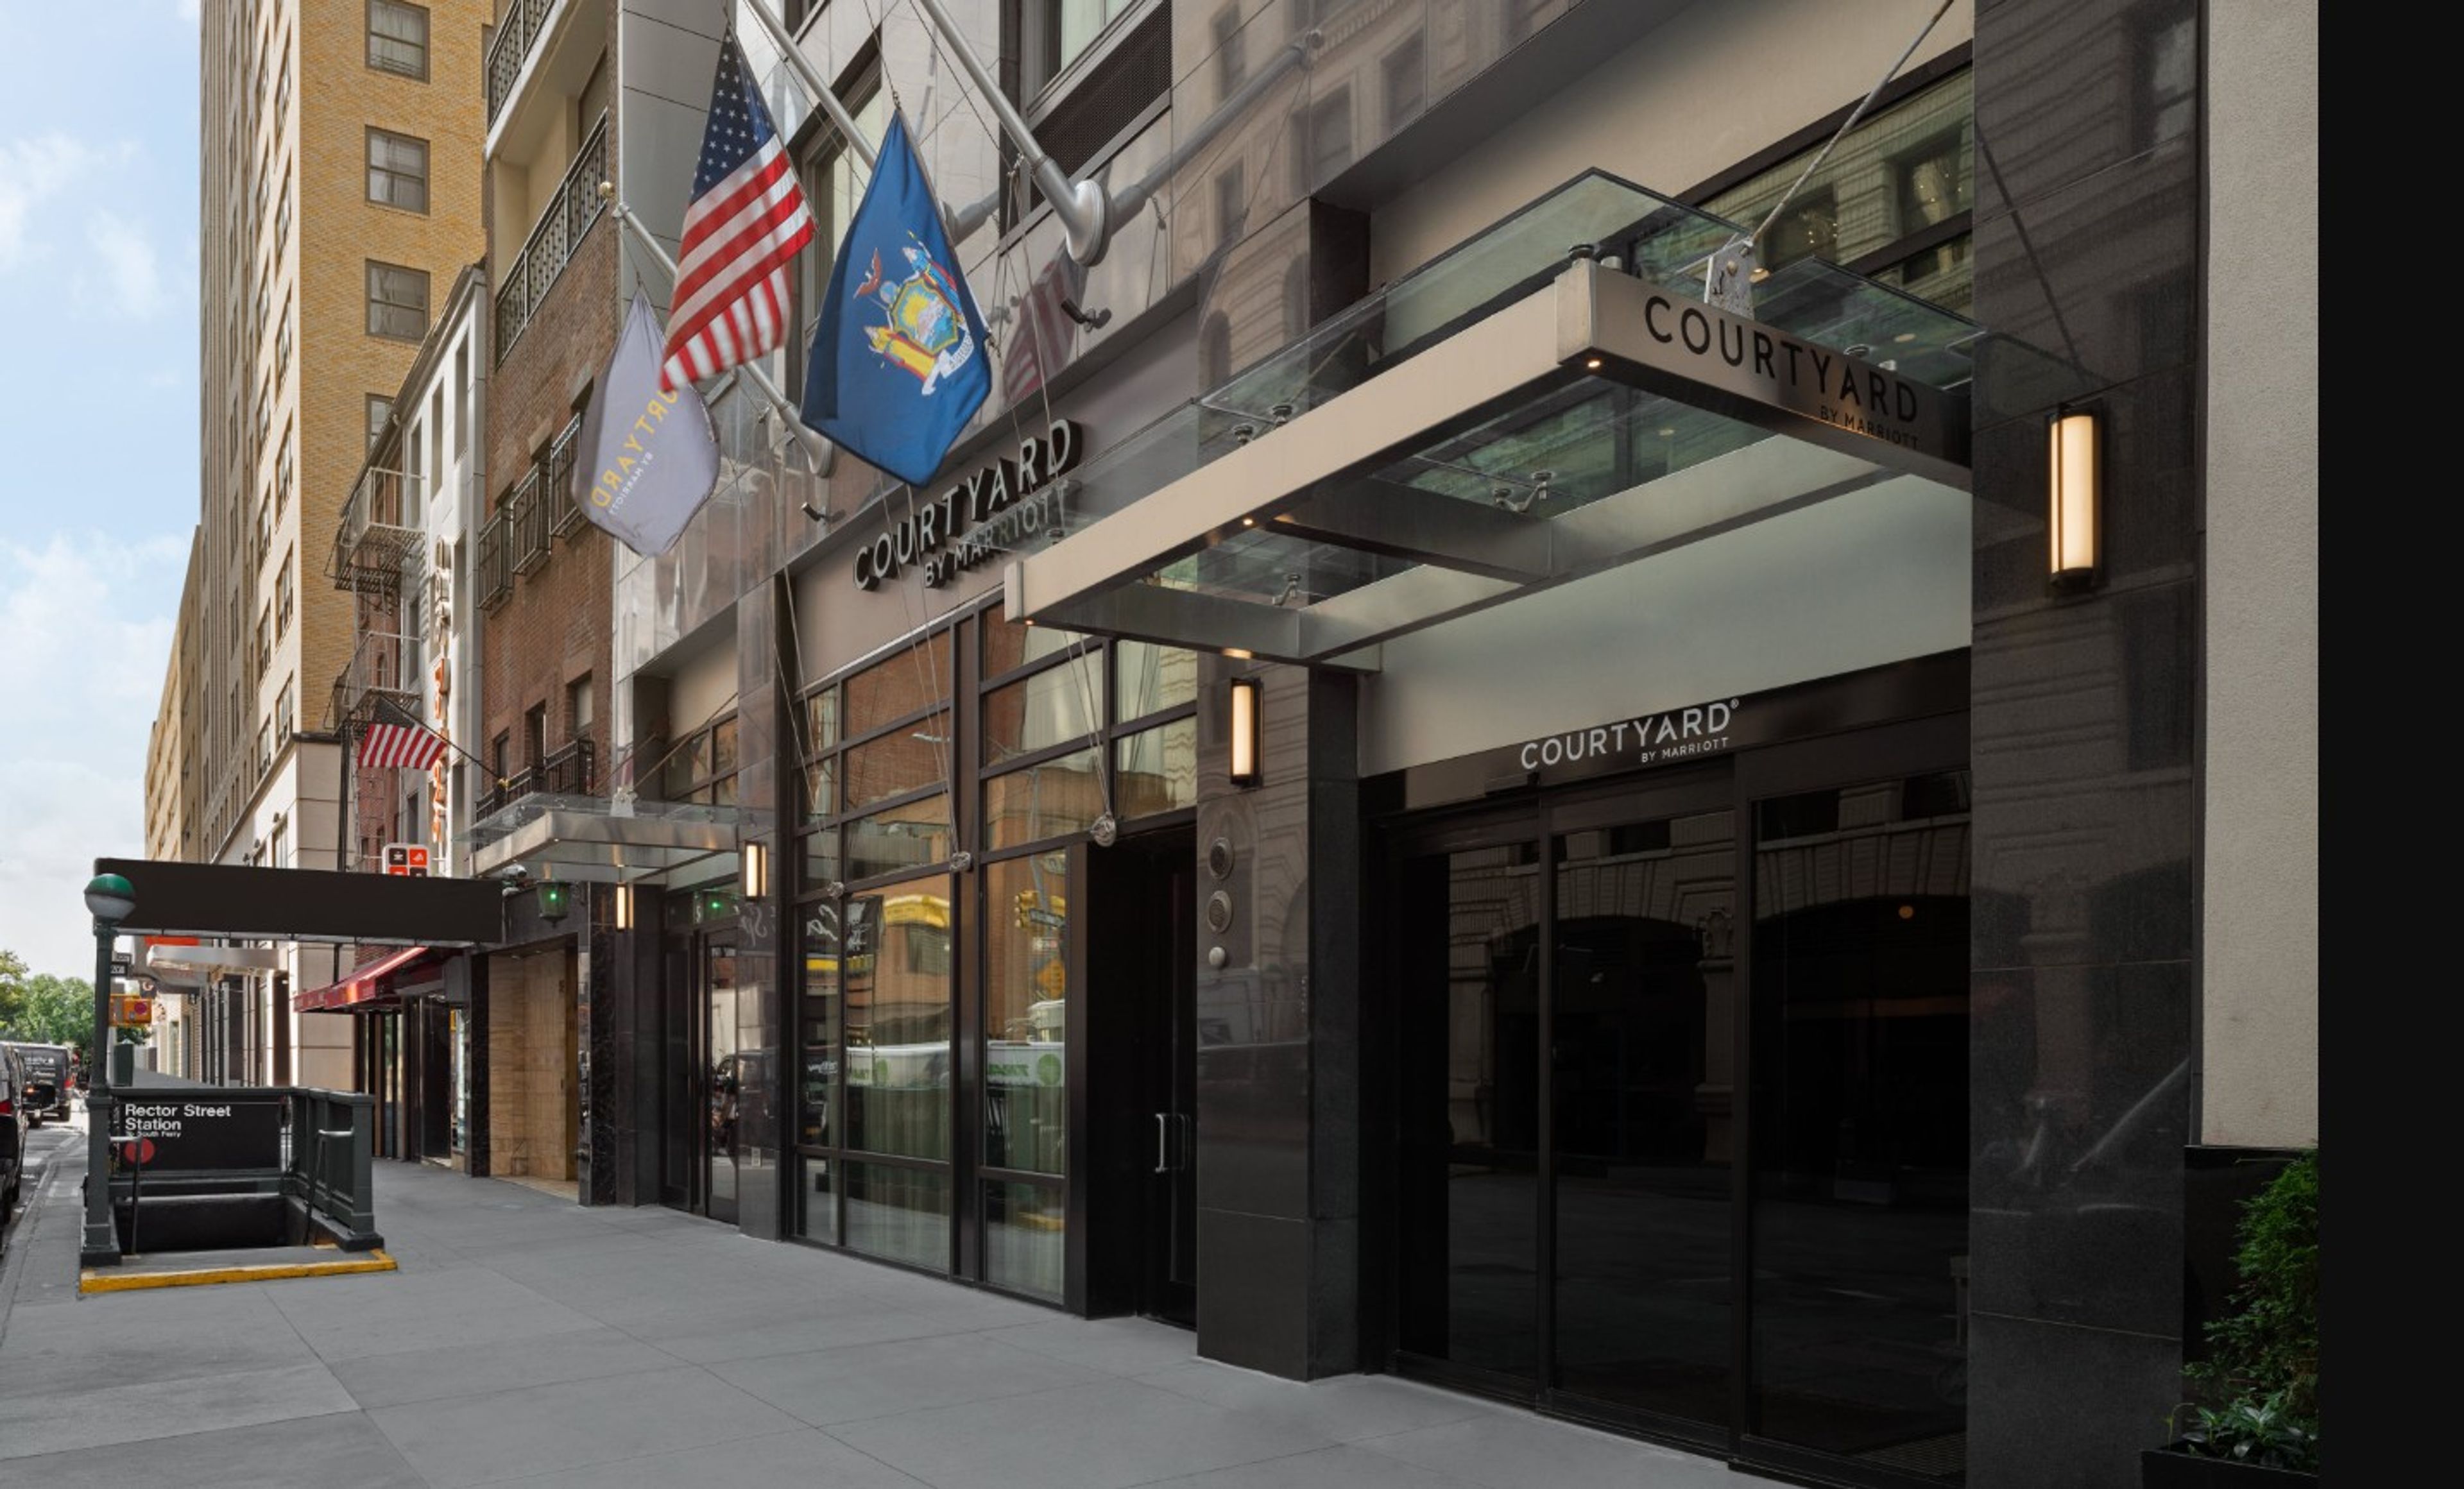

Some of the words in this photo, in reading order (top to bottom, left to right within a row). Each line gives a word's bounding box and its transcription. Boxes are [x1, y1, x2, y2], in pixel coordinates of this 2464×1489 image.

[1644, 295, 1917, 423] COURTYARD
[1820, 405, 1839, 421] BY
[1844, 412, 1919, 449] MARRIOTT
[853, 419, 1078, 590] COURTYARD
[924, 552, 948, 588] BY
[954, 479, 1070, 570] MARRIOTT
[1641, 751, 1657, 763] BY
[1661, 737, 1729, 759] MARRIOTT
[124, 1103, 178, 1117] Rector
[184, 1103, 232, 1117] Street
[124, 1117, 182, 1131] Station
